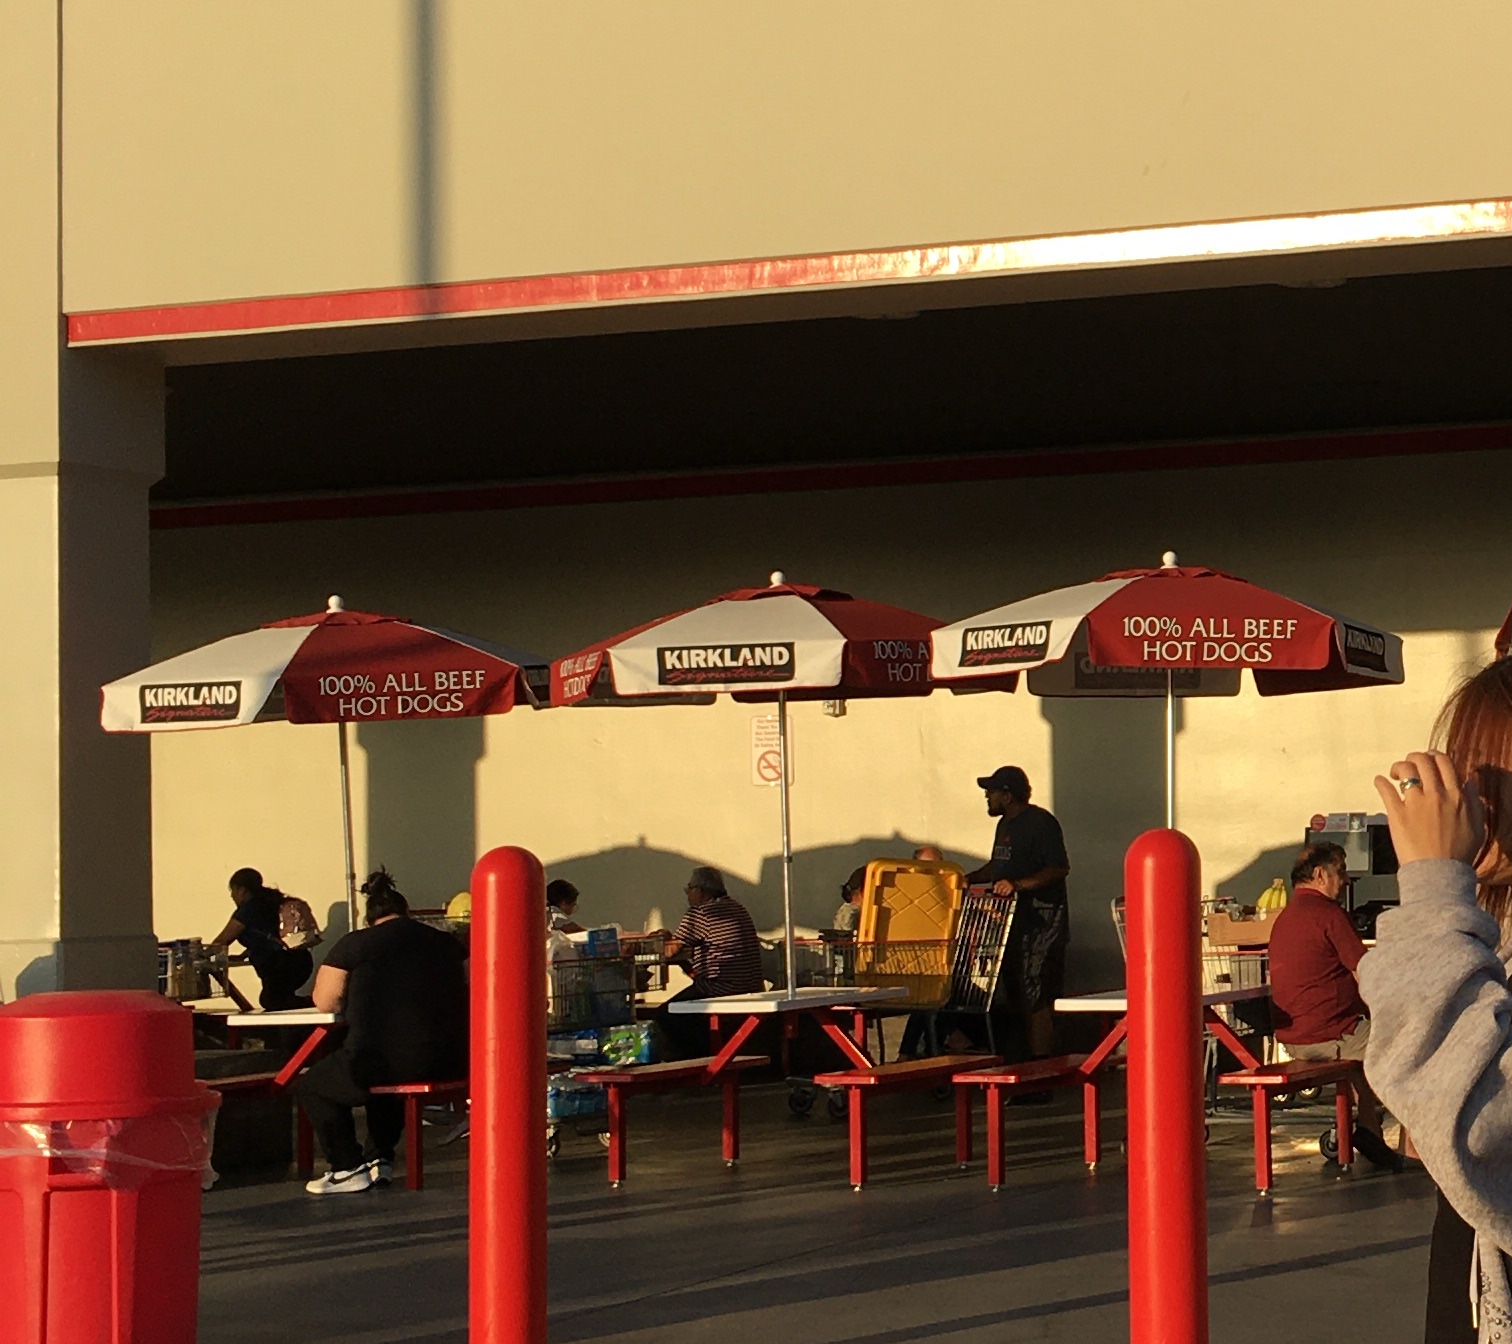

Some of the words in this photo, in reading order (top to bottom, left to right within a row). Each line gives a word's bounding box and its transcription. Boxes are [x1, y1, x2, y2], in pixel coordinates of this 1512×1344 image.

[966, 625, 1048, 650] KIRKLAND
[1122, 616, 1182, 638] 100%
[1188, 617, 1236, 638] ALL
[1243, 618, 1298, 639] BEEF
[664, 646, 790, 670] KIRKLAND
[872, 641, 913, 659] 100%
[1143, 640, 1197, 661] HOT
[1202, 641, 1273, 662] DOGS
[318, 674, 376, 695] 100%
[382, 672, 427, 693] ALL
[434, 669, 486, 691] BEEF
[887, 663, 922, 682] HOT
[145, 685, 238, 708] KIRKLAND
[339, 696, 391, 717] HOT
[397, 692, 464, 715] DOGS
